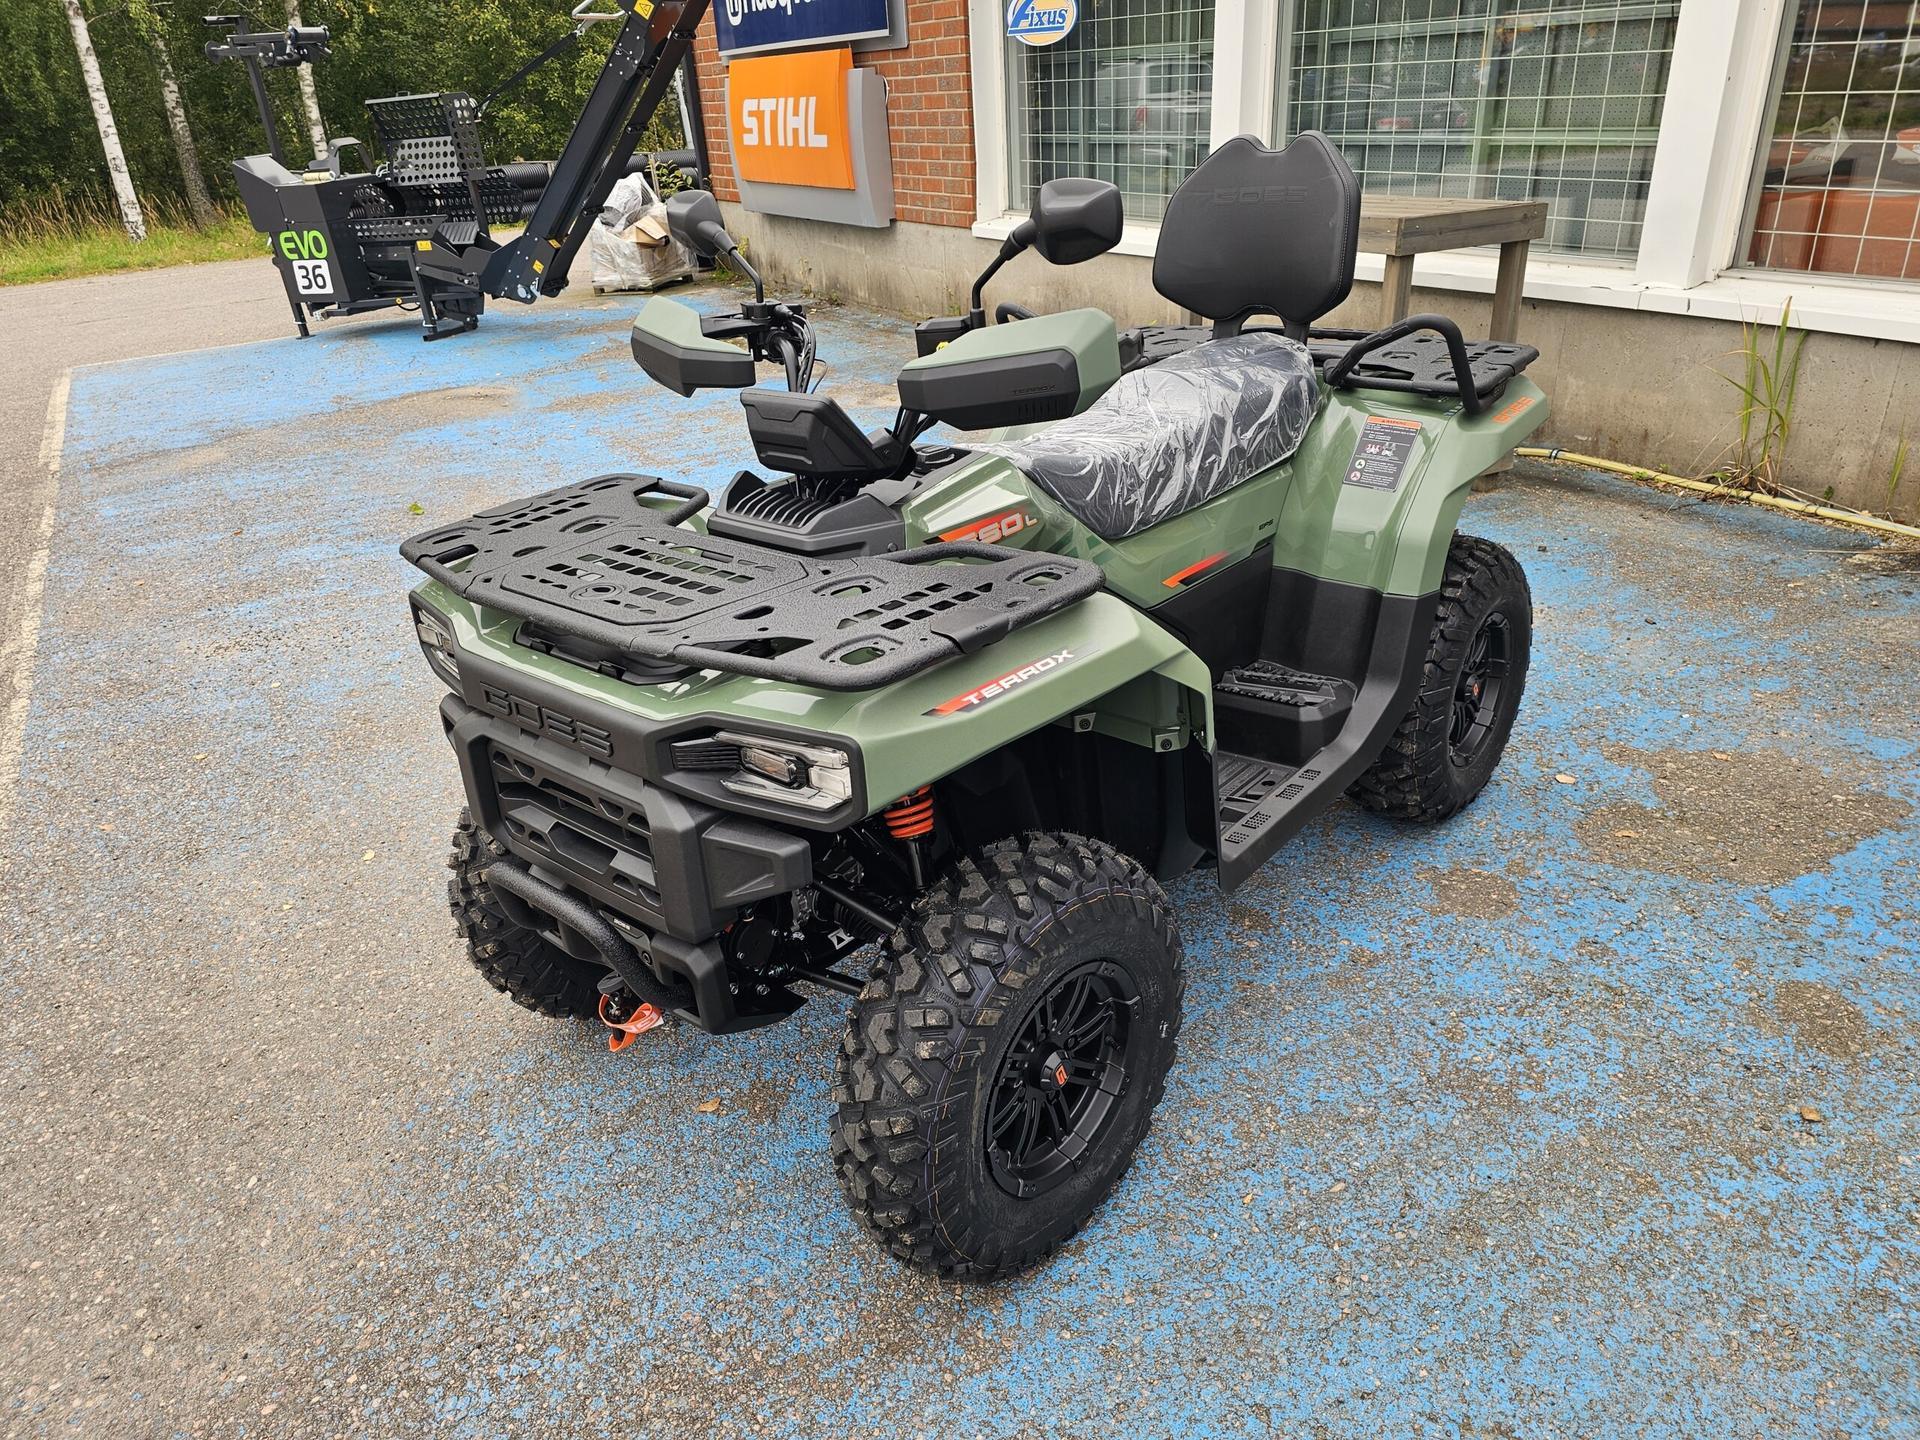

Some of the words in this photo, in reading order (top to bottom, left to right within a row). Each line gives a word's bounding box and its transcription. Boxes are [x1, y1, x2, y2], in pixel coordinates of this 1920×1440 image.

[742, 96, 828, 148] STIHL
[279, 230, 328, 260] EVO
[297, 264, 327, 290] 36
[956, 512, 1024, 544] 50
[479, 681, 614, 758] GOES
